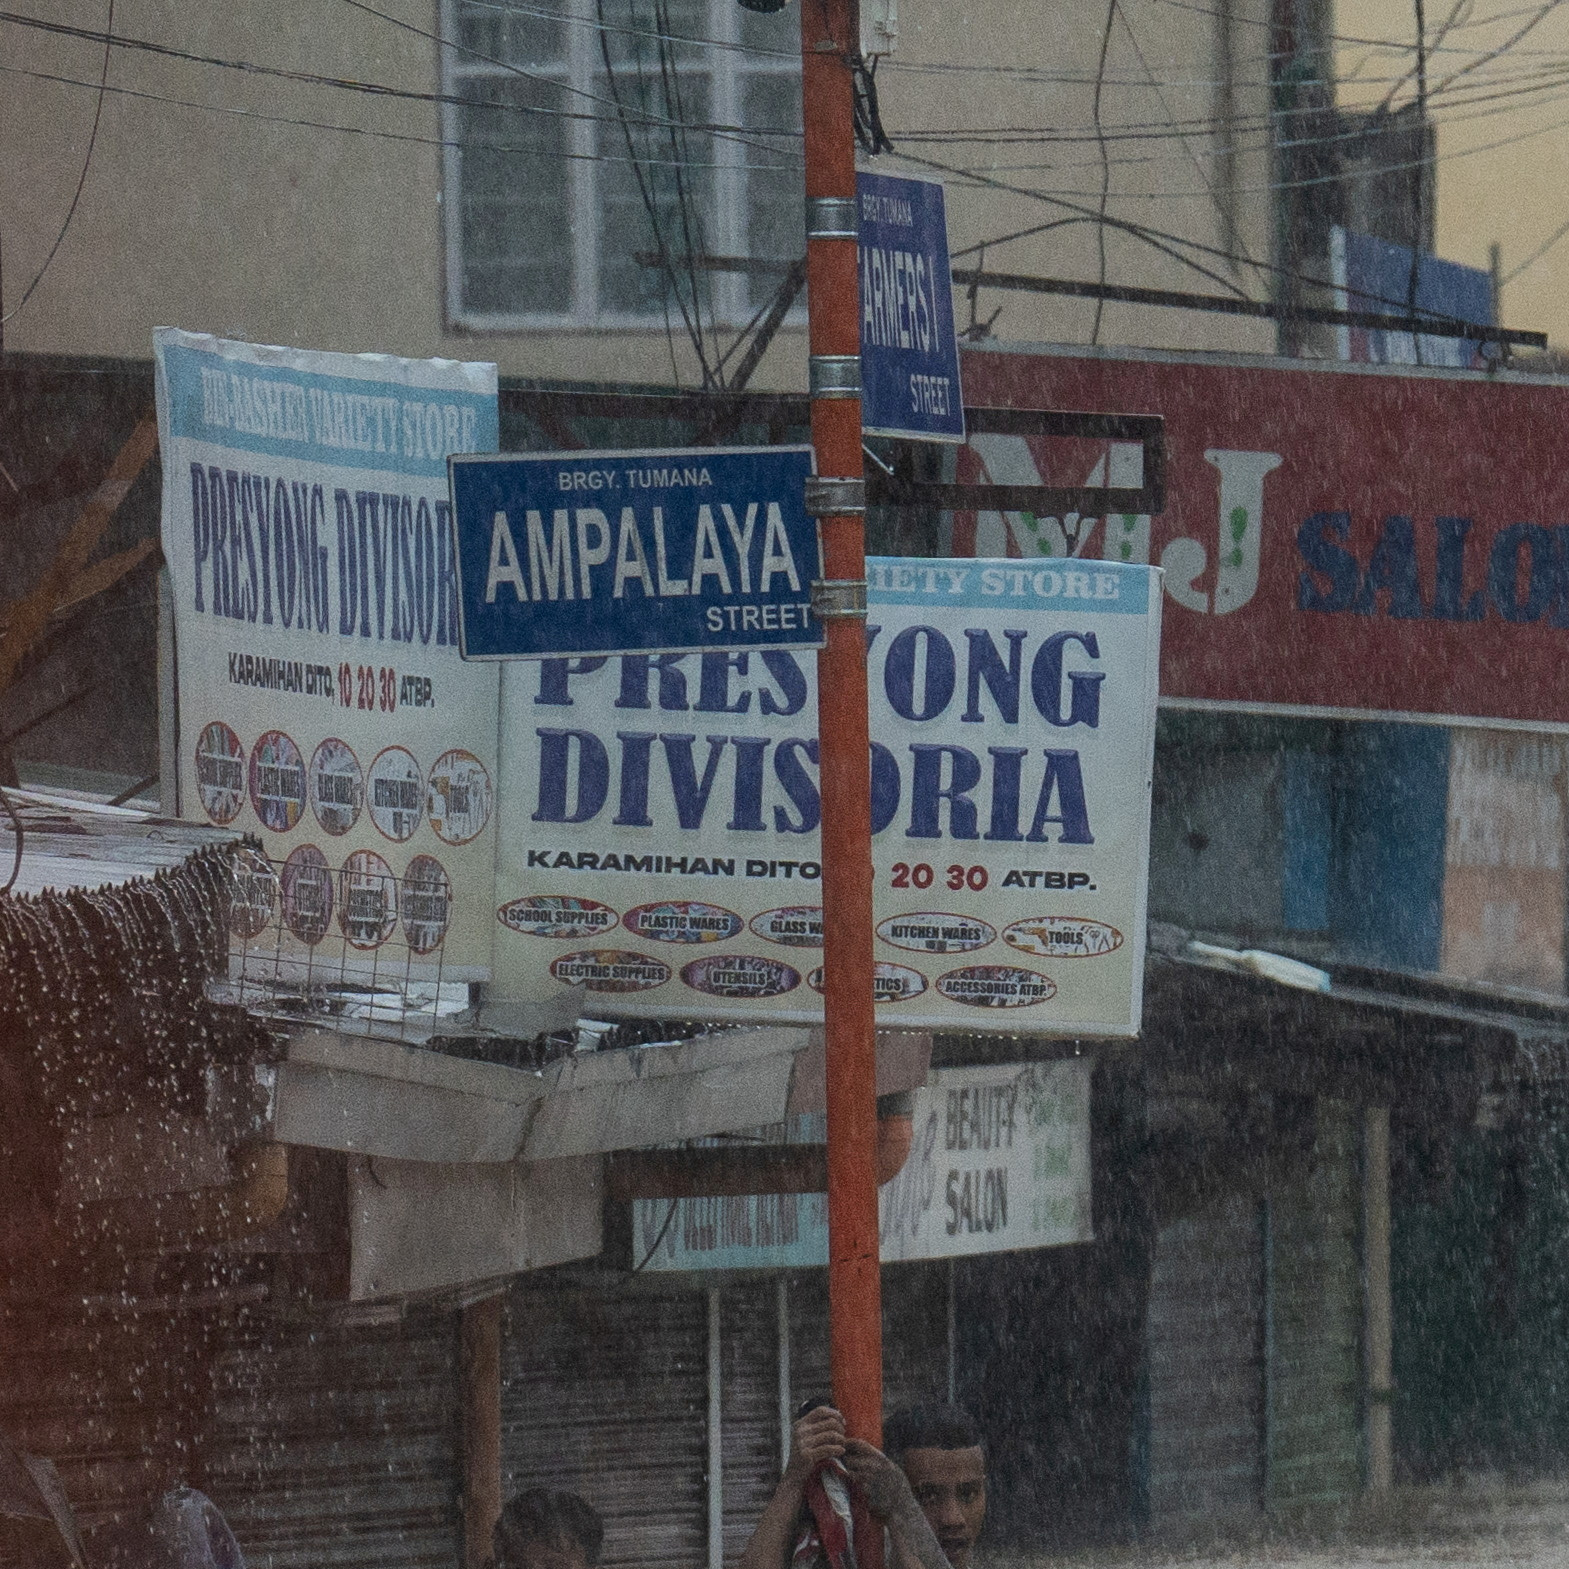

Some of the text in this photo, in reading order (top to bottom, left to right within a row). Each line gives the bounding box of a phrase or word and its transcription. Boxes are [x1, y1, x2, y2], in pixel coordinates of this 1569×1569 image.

[857, 246, 930, 352] ARMERS
[909, 373, 951, 417] STREET
[308, 386, 400, 453] VARIETY
[401, 399, 477, 460] STORE
[559, 467, 713, 491] BRGY. TUMANA
[190, 461, 330, 634] PRESYONG
[486, 502, 802, 603] AMPALAYA
[866, 563, 1121, 600] IETY STORE
[706, 603, 813, 632] STREET
[229, 652, 303, 694] KARAMIHAN
[338, 662, 352, 708] 10
[358, 664, 375, 711] 20
[380, 666, 396, 713] 30
[400, 675, 435, 708] ATBP.
[527, 849, 735, 877] KARAMIHAN
[890, 862, 934, 889] 20
[946, 864, 989, 892] 30
[1002, 869, 1098, 891] ATBP.
[508, 908, 608, 926] SCHOOL SUPPLIES
[640, 913, 730, 932] PLASTIC WARES
[770, 920, 806, 935] GLASS
[891, 924, 982, 941] KITCHEN WARES
[1049, 930, 1084, 946] TOOLS
[557, 963, 666, 981] ELECTRIC SUPPLIES
[713, 970, 766, 986] UTENSILS
[945, 980, 1048, 997] ACCESSORIES ATBP.
[945, 1082, 1019, 1151] BEAUTY
[945, 1166, 1008, 1236] SALON
